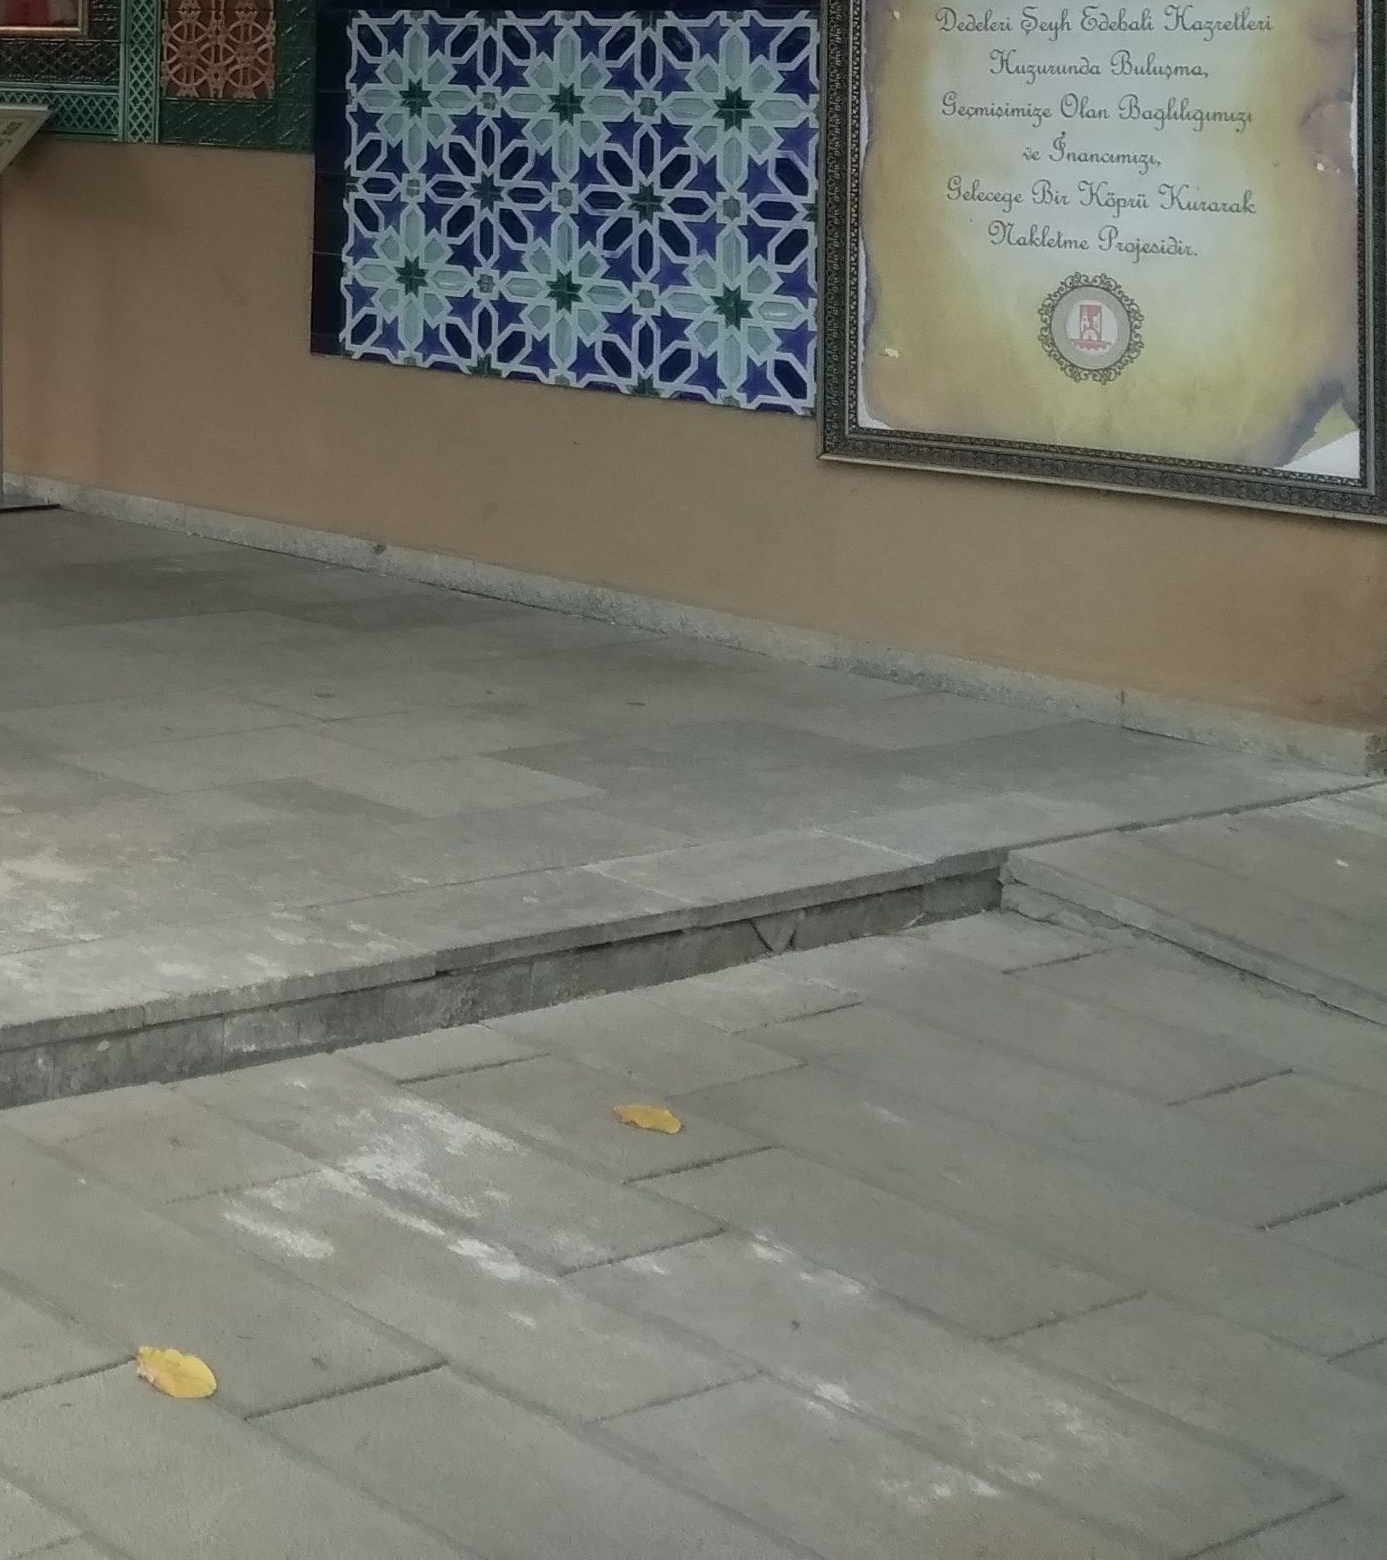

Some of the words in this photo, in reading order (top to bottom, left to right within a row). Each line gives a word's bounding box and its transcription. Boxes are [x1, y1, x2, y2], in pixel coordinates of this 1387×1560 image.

[935, 6, 1012, 33] Dedeleri
[1019, 6, 1073, 41] Şeyh
[1080, 5, 1155, 33] Edebali
[1164, 4, 1273, 41] Hazretleri
[989, 49, 1102, 85] Huzurunda
[1110, 49, 1210, 80] Buluşma,
[941, 90, 1053, 127] Geçmişimize
[1060, 93, 1110, 120] Olan
[1022, 147, 1041, 162] ve
[1030, 178, 1070, 206] Bir
[1077, 180, 1150, 218] Köprü
[1158, 183, 1256, 215] Kurarak
[988, 219, 1090, 250] Nakletme
[1098, 224, 1199, 264] Projesidir.
